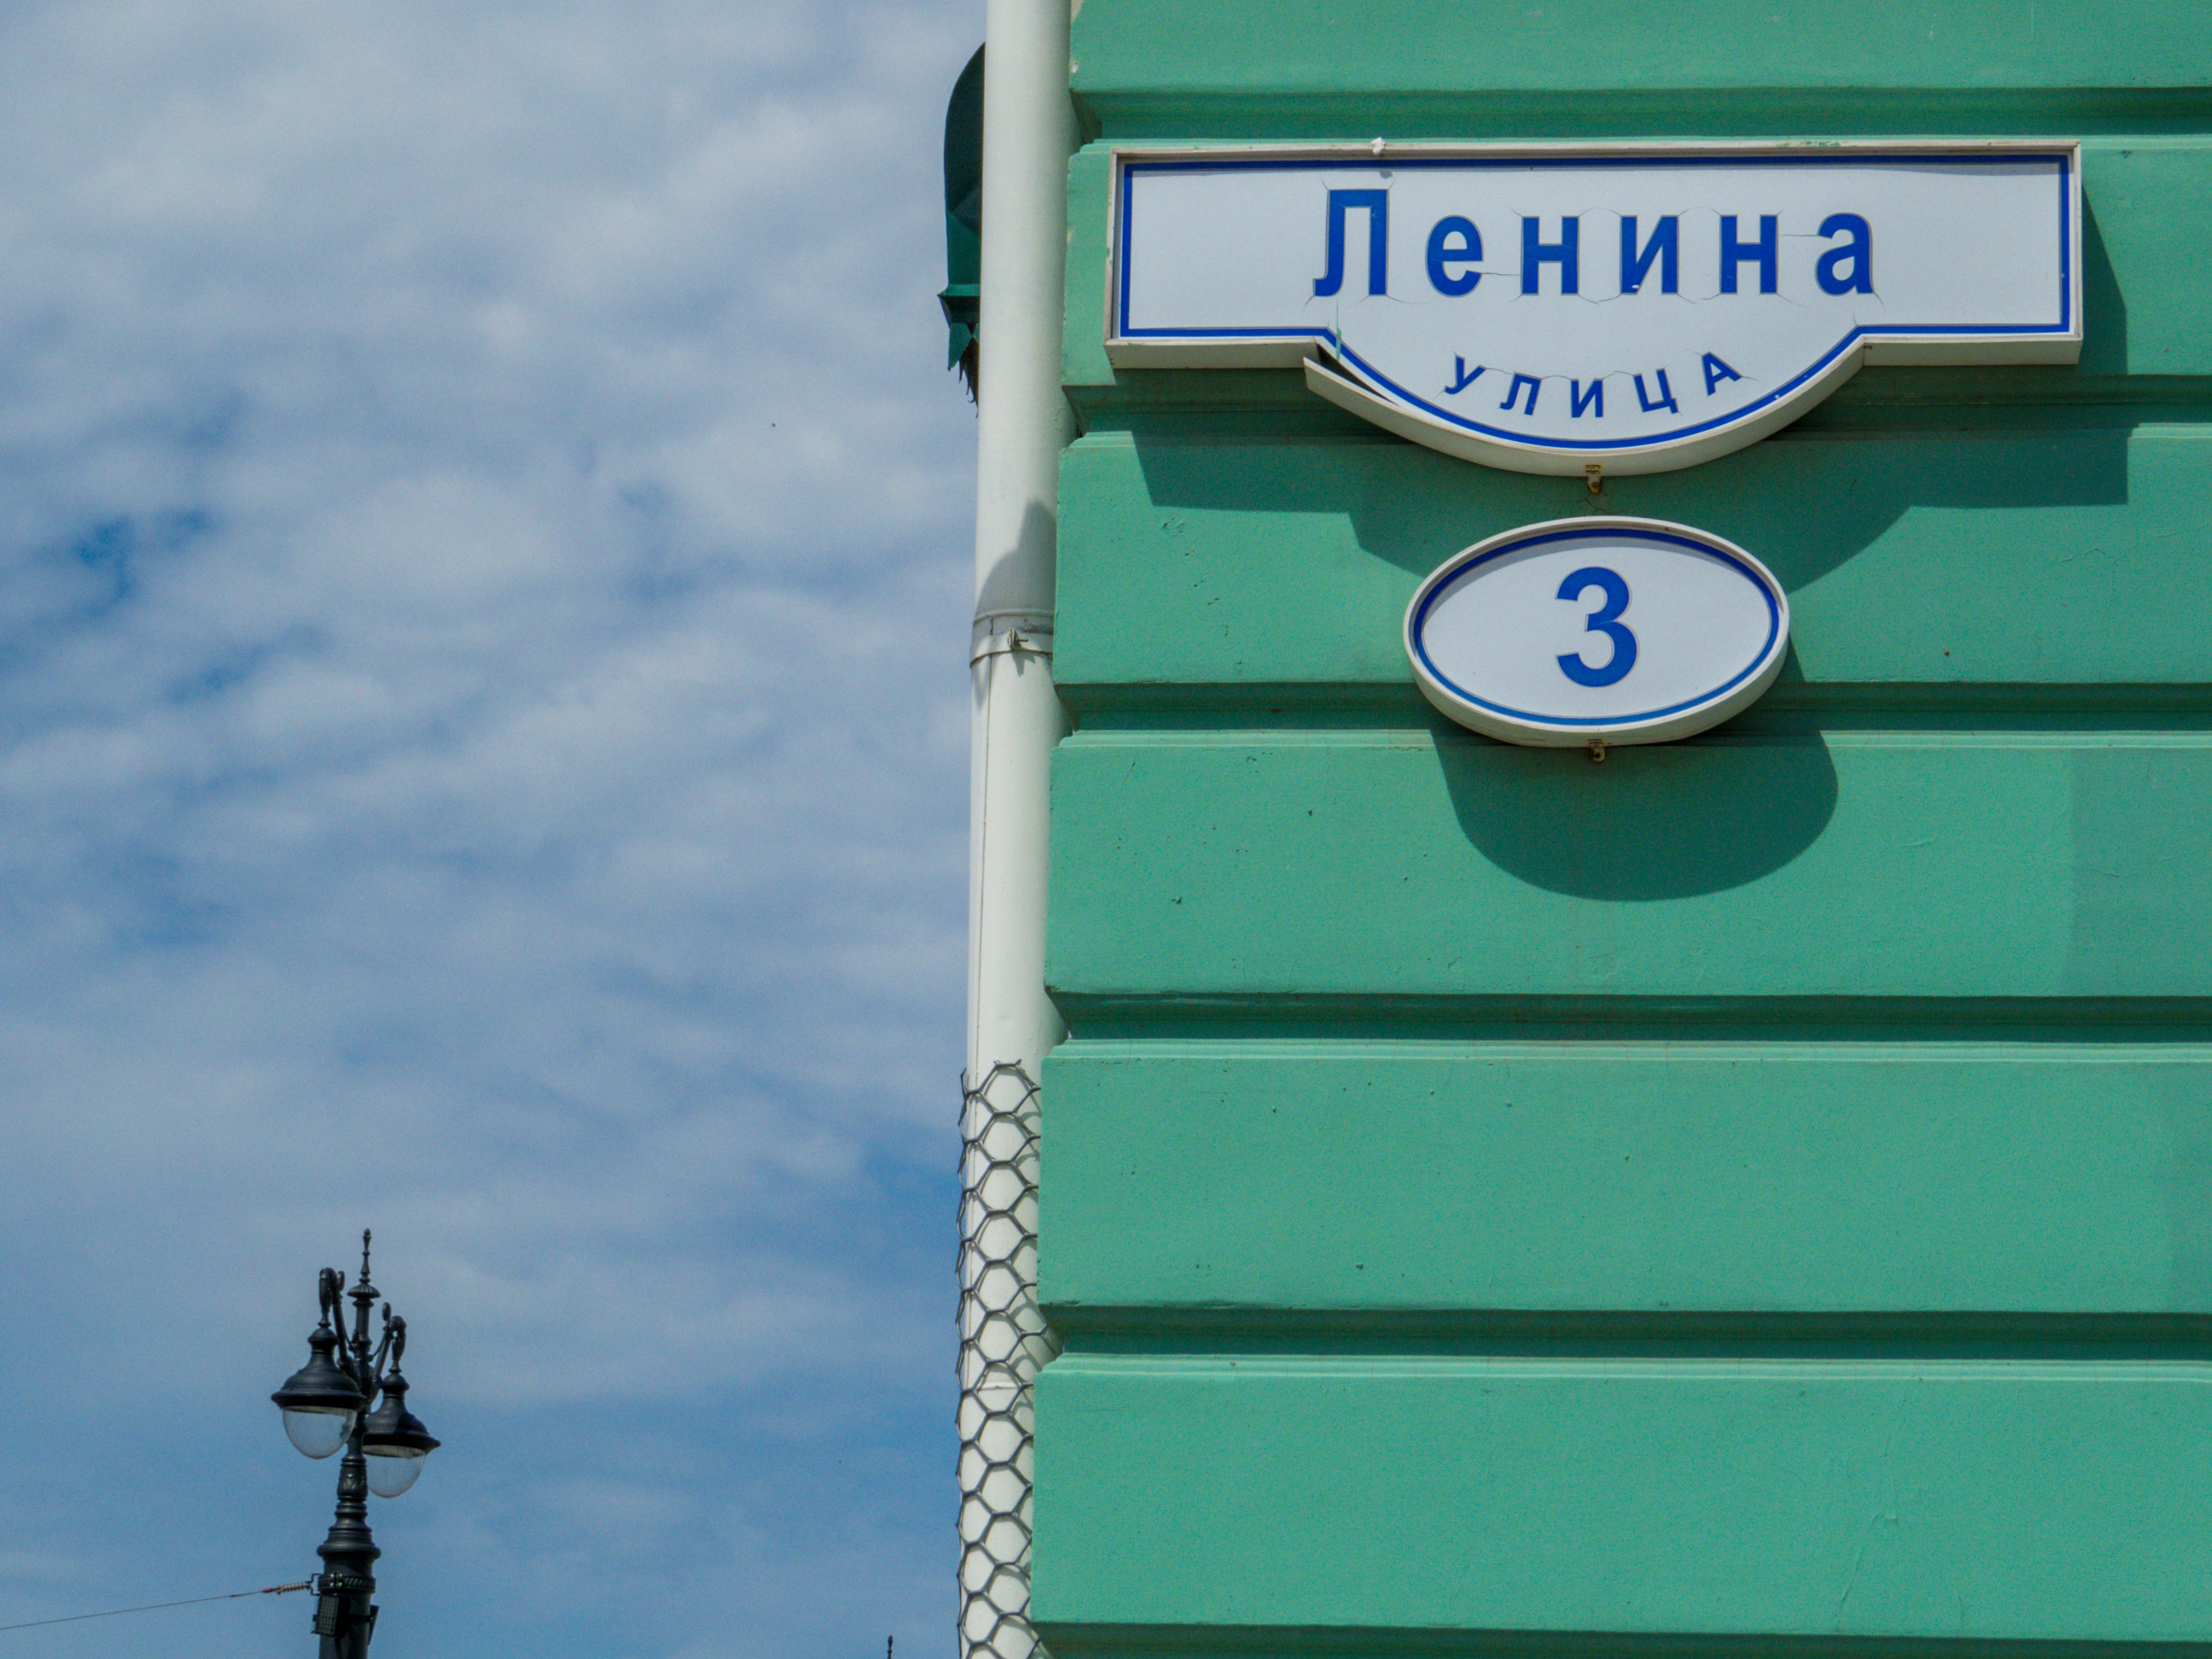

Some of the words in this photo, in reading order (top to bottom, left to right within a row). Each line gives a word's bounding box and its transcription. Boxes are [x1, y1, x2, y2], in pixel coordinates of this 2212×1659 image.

[1314, 189, 1873, 297] Ленина
[1444, 352, 1742, 418] УЛИЦА
[1556, 566, 1637, 688] 3
